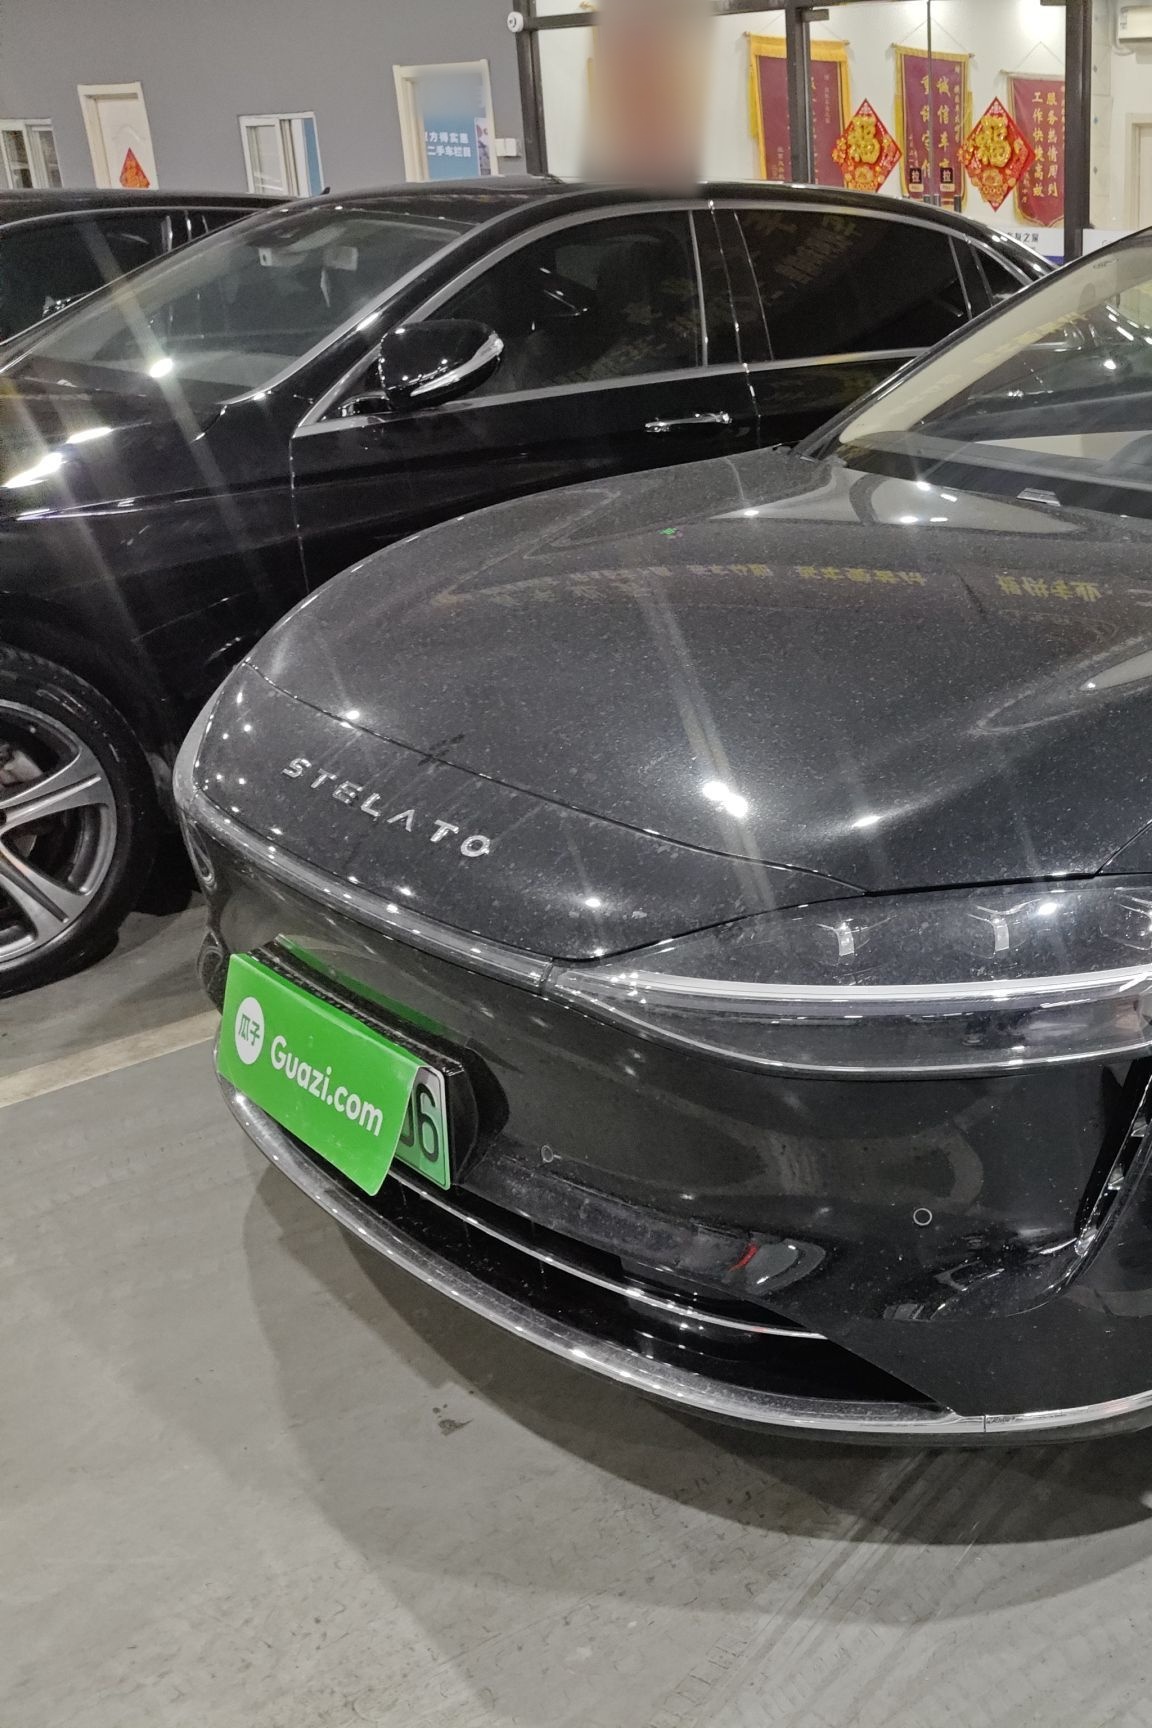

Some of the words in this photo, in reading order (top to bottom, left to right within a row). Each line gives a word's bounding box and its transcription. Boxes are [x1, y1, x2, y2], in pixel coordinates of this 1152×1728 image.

[282, 757, 491, 858] STELATO
[238, 1012, 261, 1047] 瓜子
[270, 1035, 384, 1137] Guazi.com
